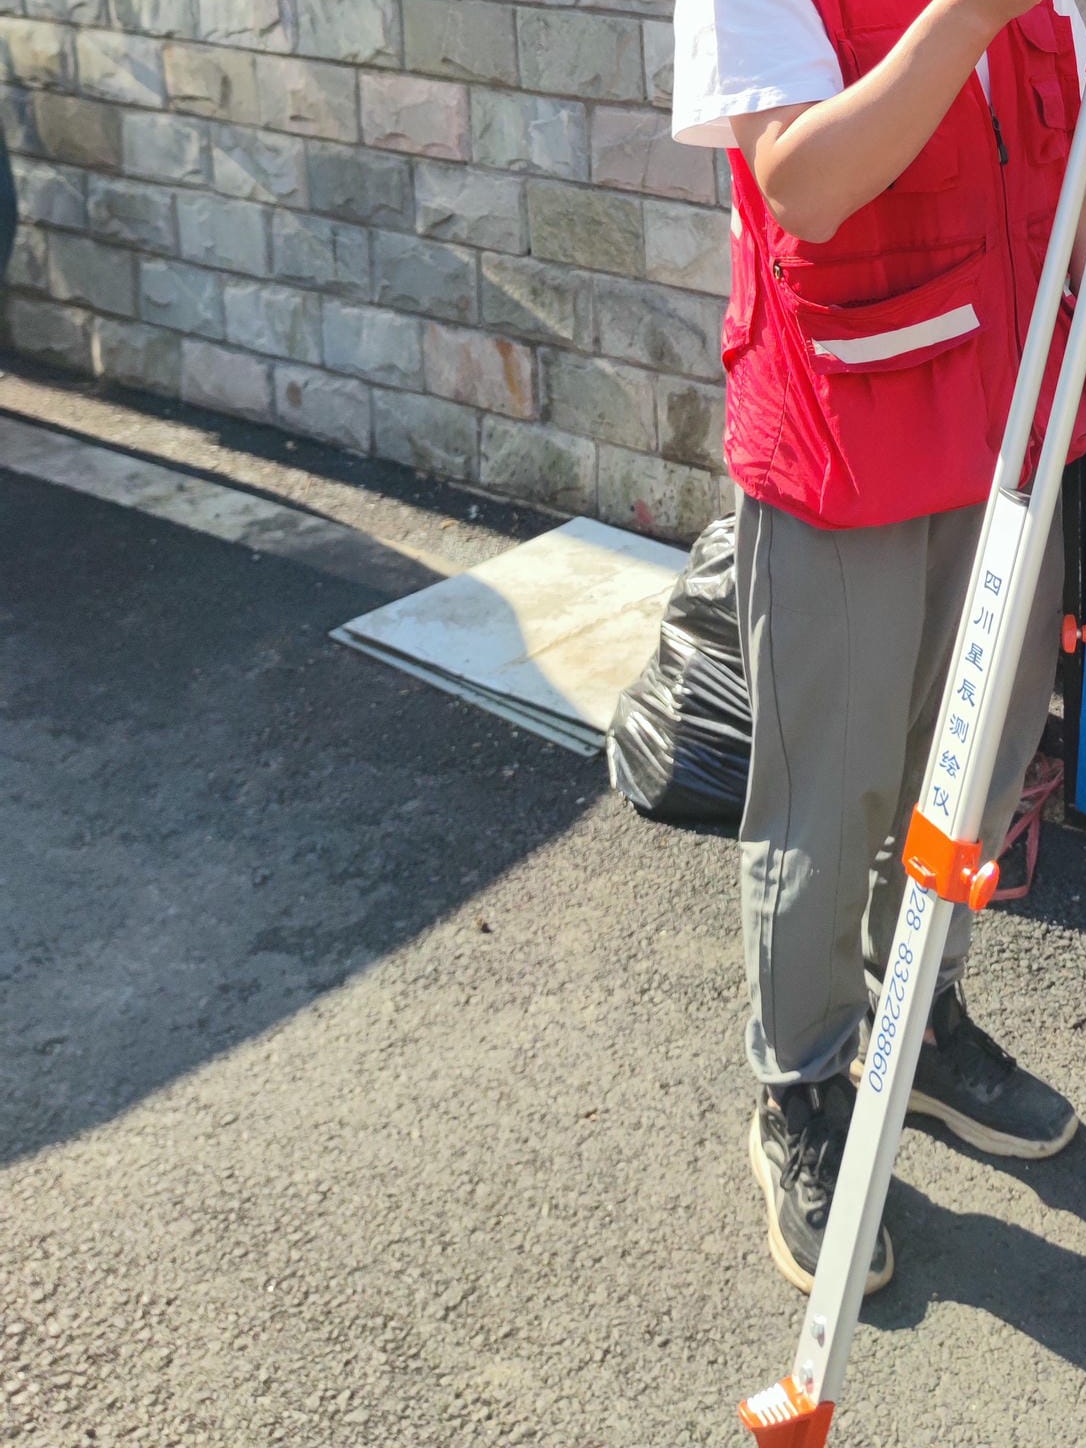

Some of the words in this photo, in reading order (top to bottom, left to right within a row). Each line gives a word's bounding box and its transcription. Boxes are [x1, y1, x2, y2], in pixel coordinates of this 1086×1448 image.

[934, 569, 1002, 817] 四川星辰测绘仪
